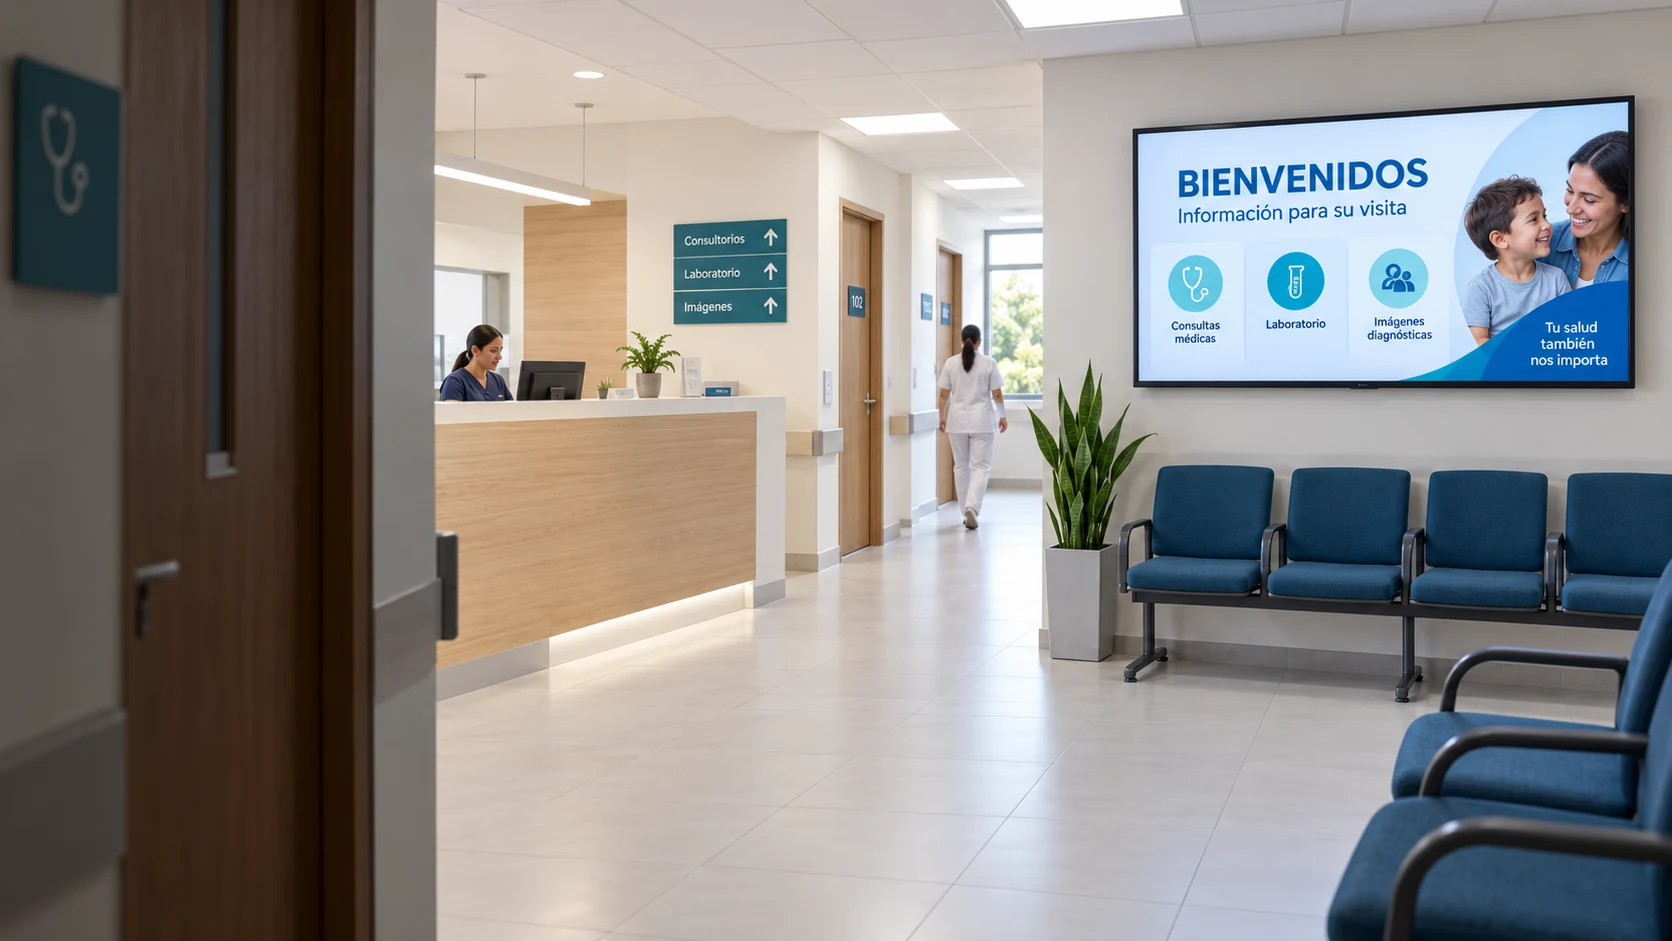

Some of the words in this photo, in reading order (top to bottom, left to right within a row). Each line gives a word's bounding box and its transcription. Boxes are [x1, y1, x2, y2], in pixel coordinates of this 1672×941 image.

[1178, 157, 1429, 198] BIENVENIDOS
[1178, 203, 1283, 224] Información
[1288, 206, 1328, 224] para
[1333, 205, 1354, 218] su
[1360, 199, 1407, 217] visita
[684, 234, 745, 246] Consultorios
[684, 267, 741, 279] Laboratorio
[684, 301, 733, 314] Imágenes
[851, 295, 863, 309] 102
[1171, 320, 1221, 331] Consultas
[1266, 318, 1326, 330] Laboratorio
[1373, 317, 1425, 330] Imágenes
[1545, 321, 1561, 334] Tu
[1564, 320, 1598, 334] salud
[1175, 333, 1216, 344] médicas
[1367, 329, 1433, 343] diagnósticas
[1540, 337, 1595, 350] también
[1530, 356, 1554, 366] nos
[1557, 353, 1608, 369] importa
